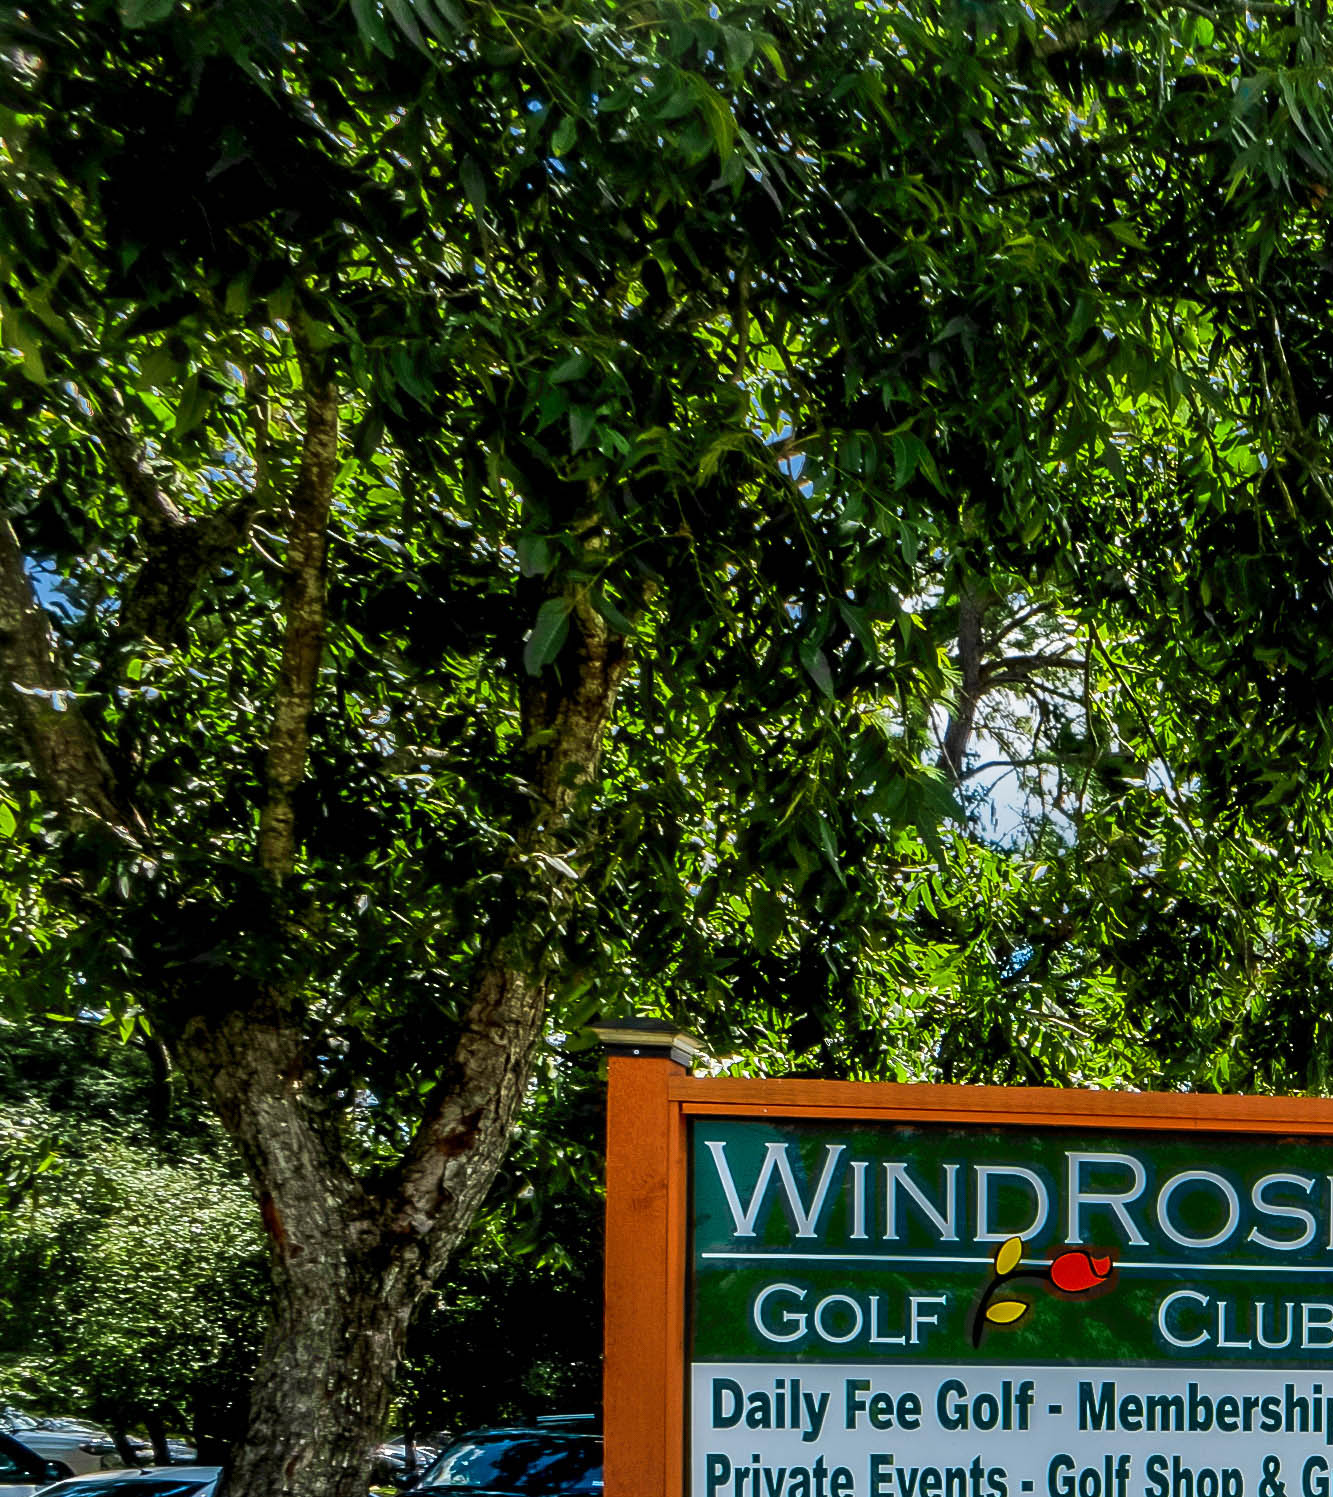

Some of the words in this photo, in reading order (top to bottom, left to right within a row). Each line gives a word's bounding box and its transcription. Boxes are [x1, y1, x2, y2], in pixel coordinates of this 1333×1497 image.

[754, 1283, 947, 1345] GOLF
[711, 1378, 829, 1443] Daily
[845, 1379, 922, 1431] Fee
[936, 1379, 1035, 1433] Golf
